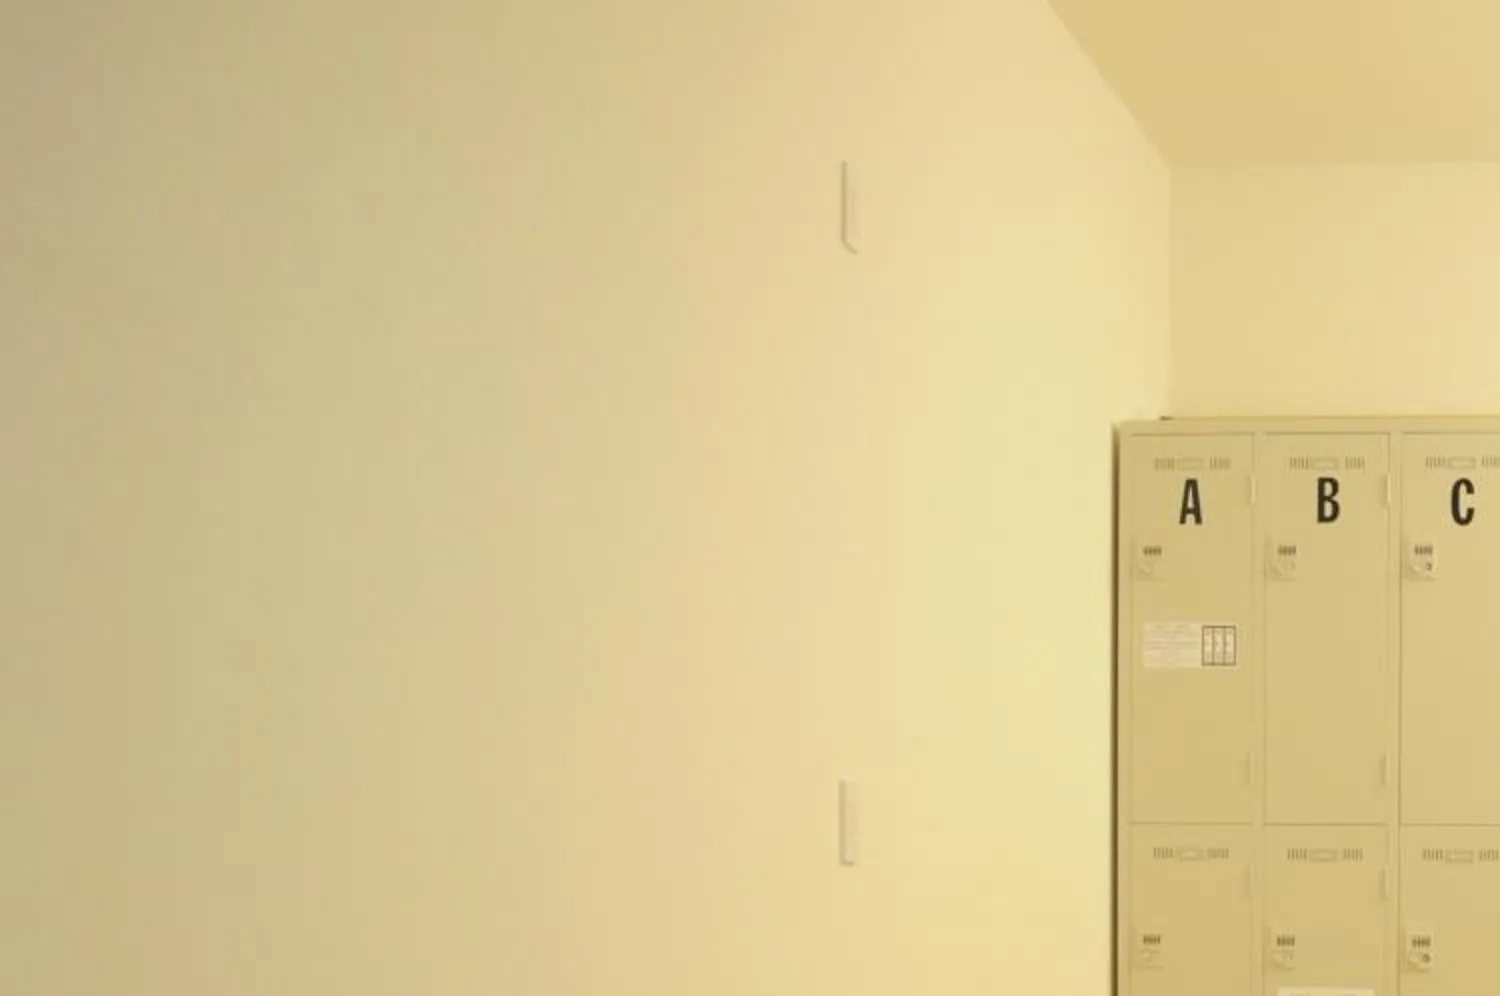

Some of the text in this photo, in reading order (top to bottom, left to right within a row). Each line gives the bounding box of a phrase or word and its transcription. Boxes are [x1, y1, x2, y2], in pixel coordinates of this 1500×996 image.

[1179, 478, 1203, 525] A
[1317, 476, 1341, 524] B
[1450, 477, 1475, 526] C
